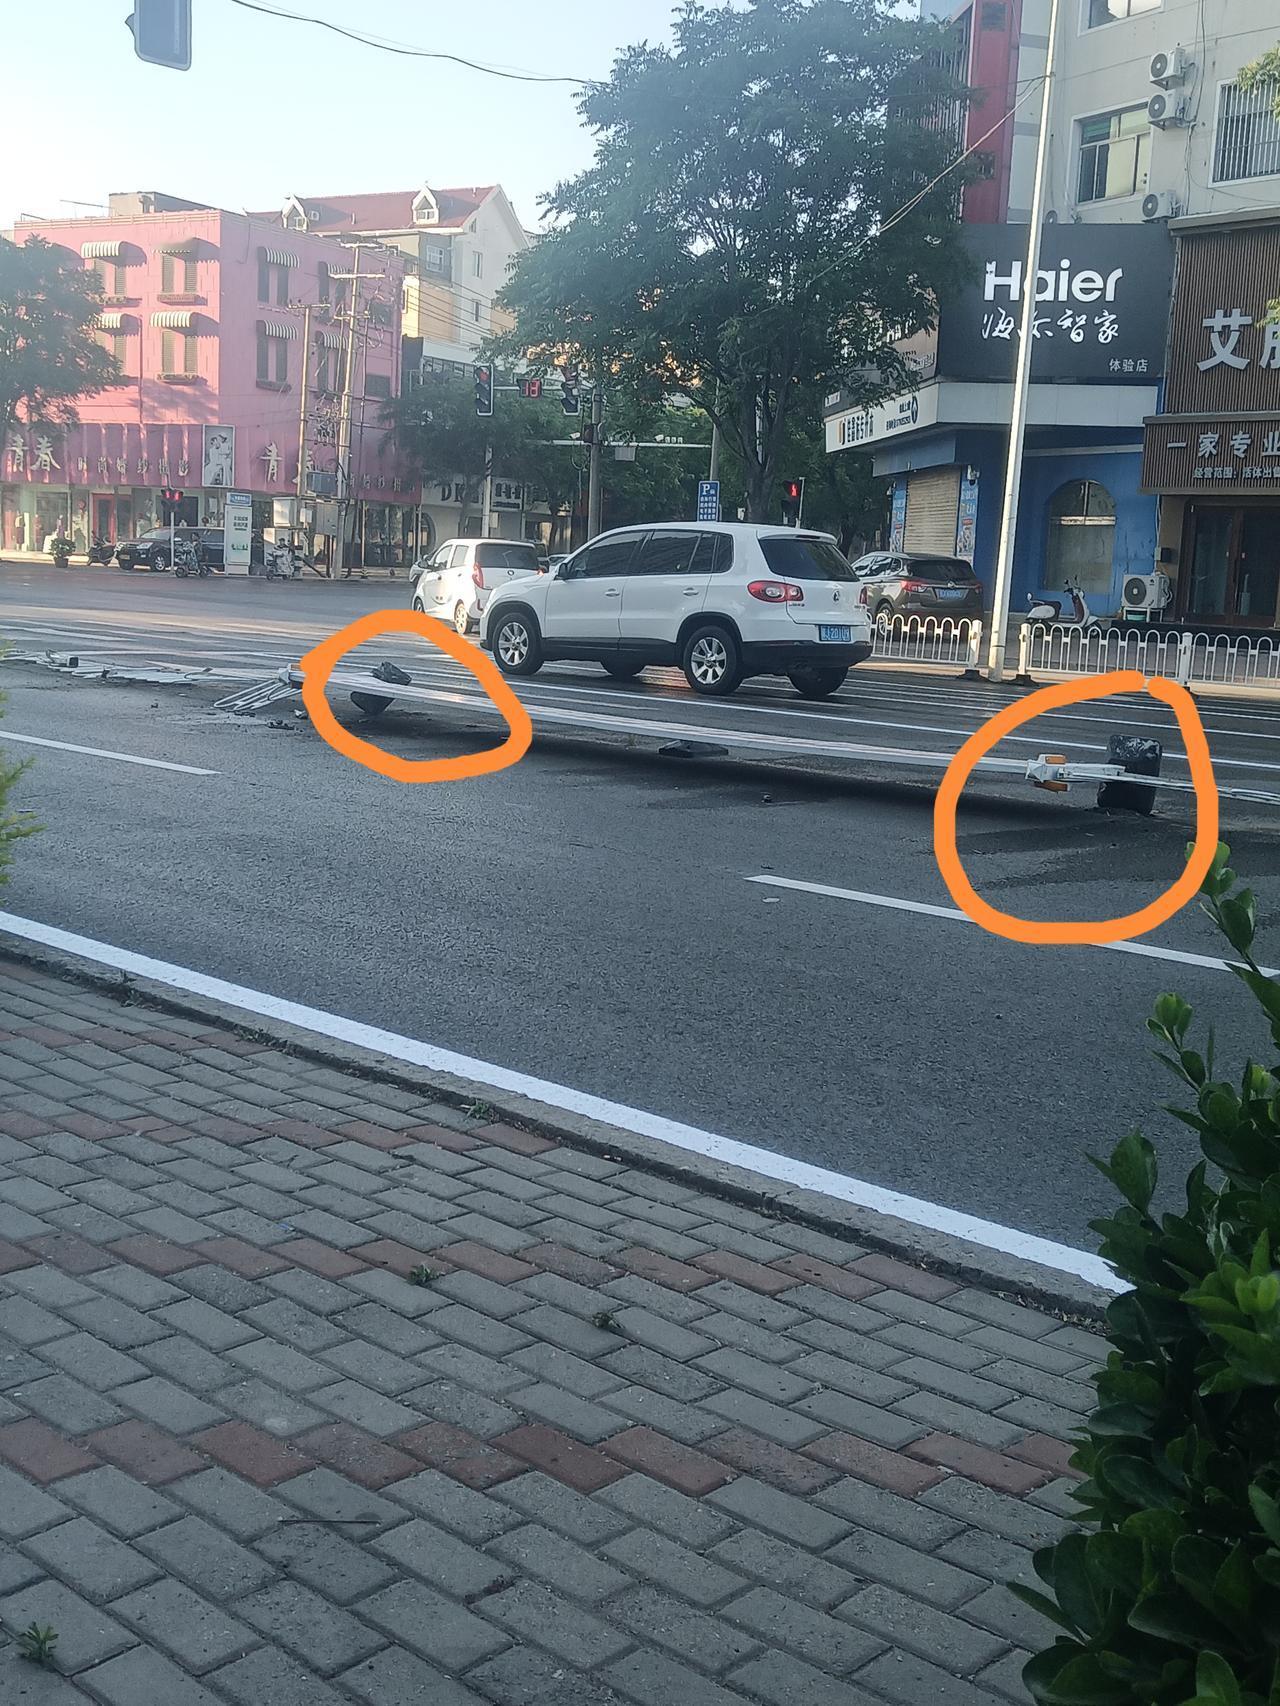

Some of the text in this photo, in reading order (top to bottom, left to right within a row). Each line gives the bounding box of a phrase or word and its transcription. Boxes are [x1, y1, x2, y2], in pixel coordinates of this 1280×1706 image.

[984, 259, 1123, 301] Haier
[1109, 358, 1148, 372] 体验店
[6, 434, 61, 472] 青春
